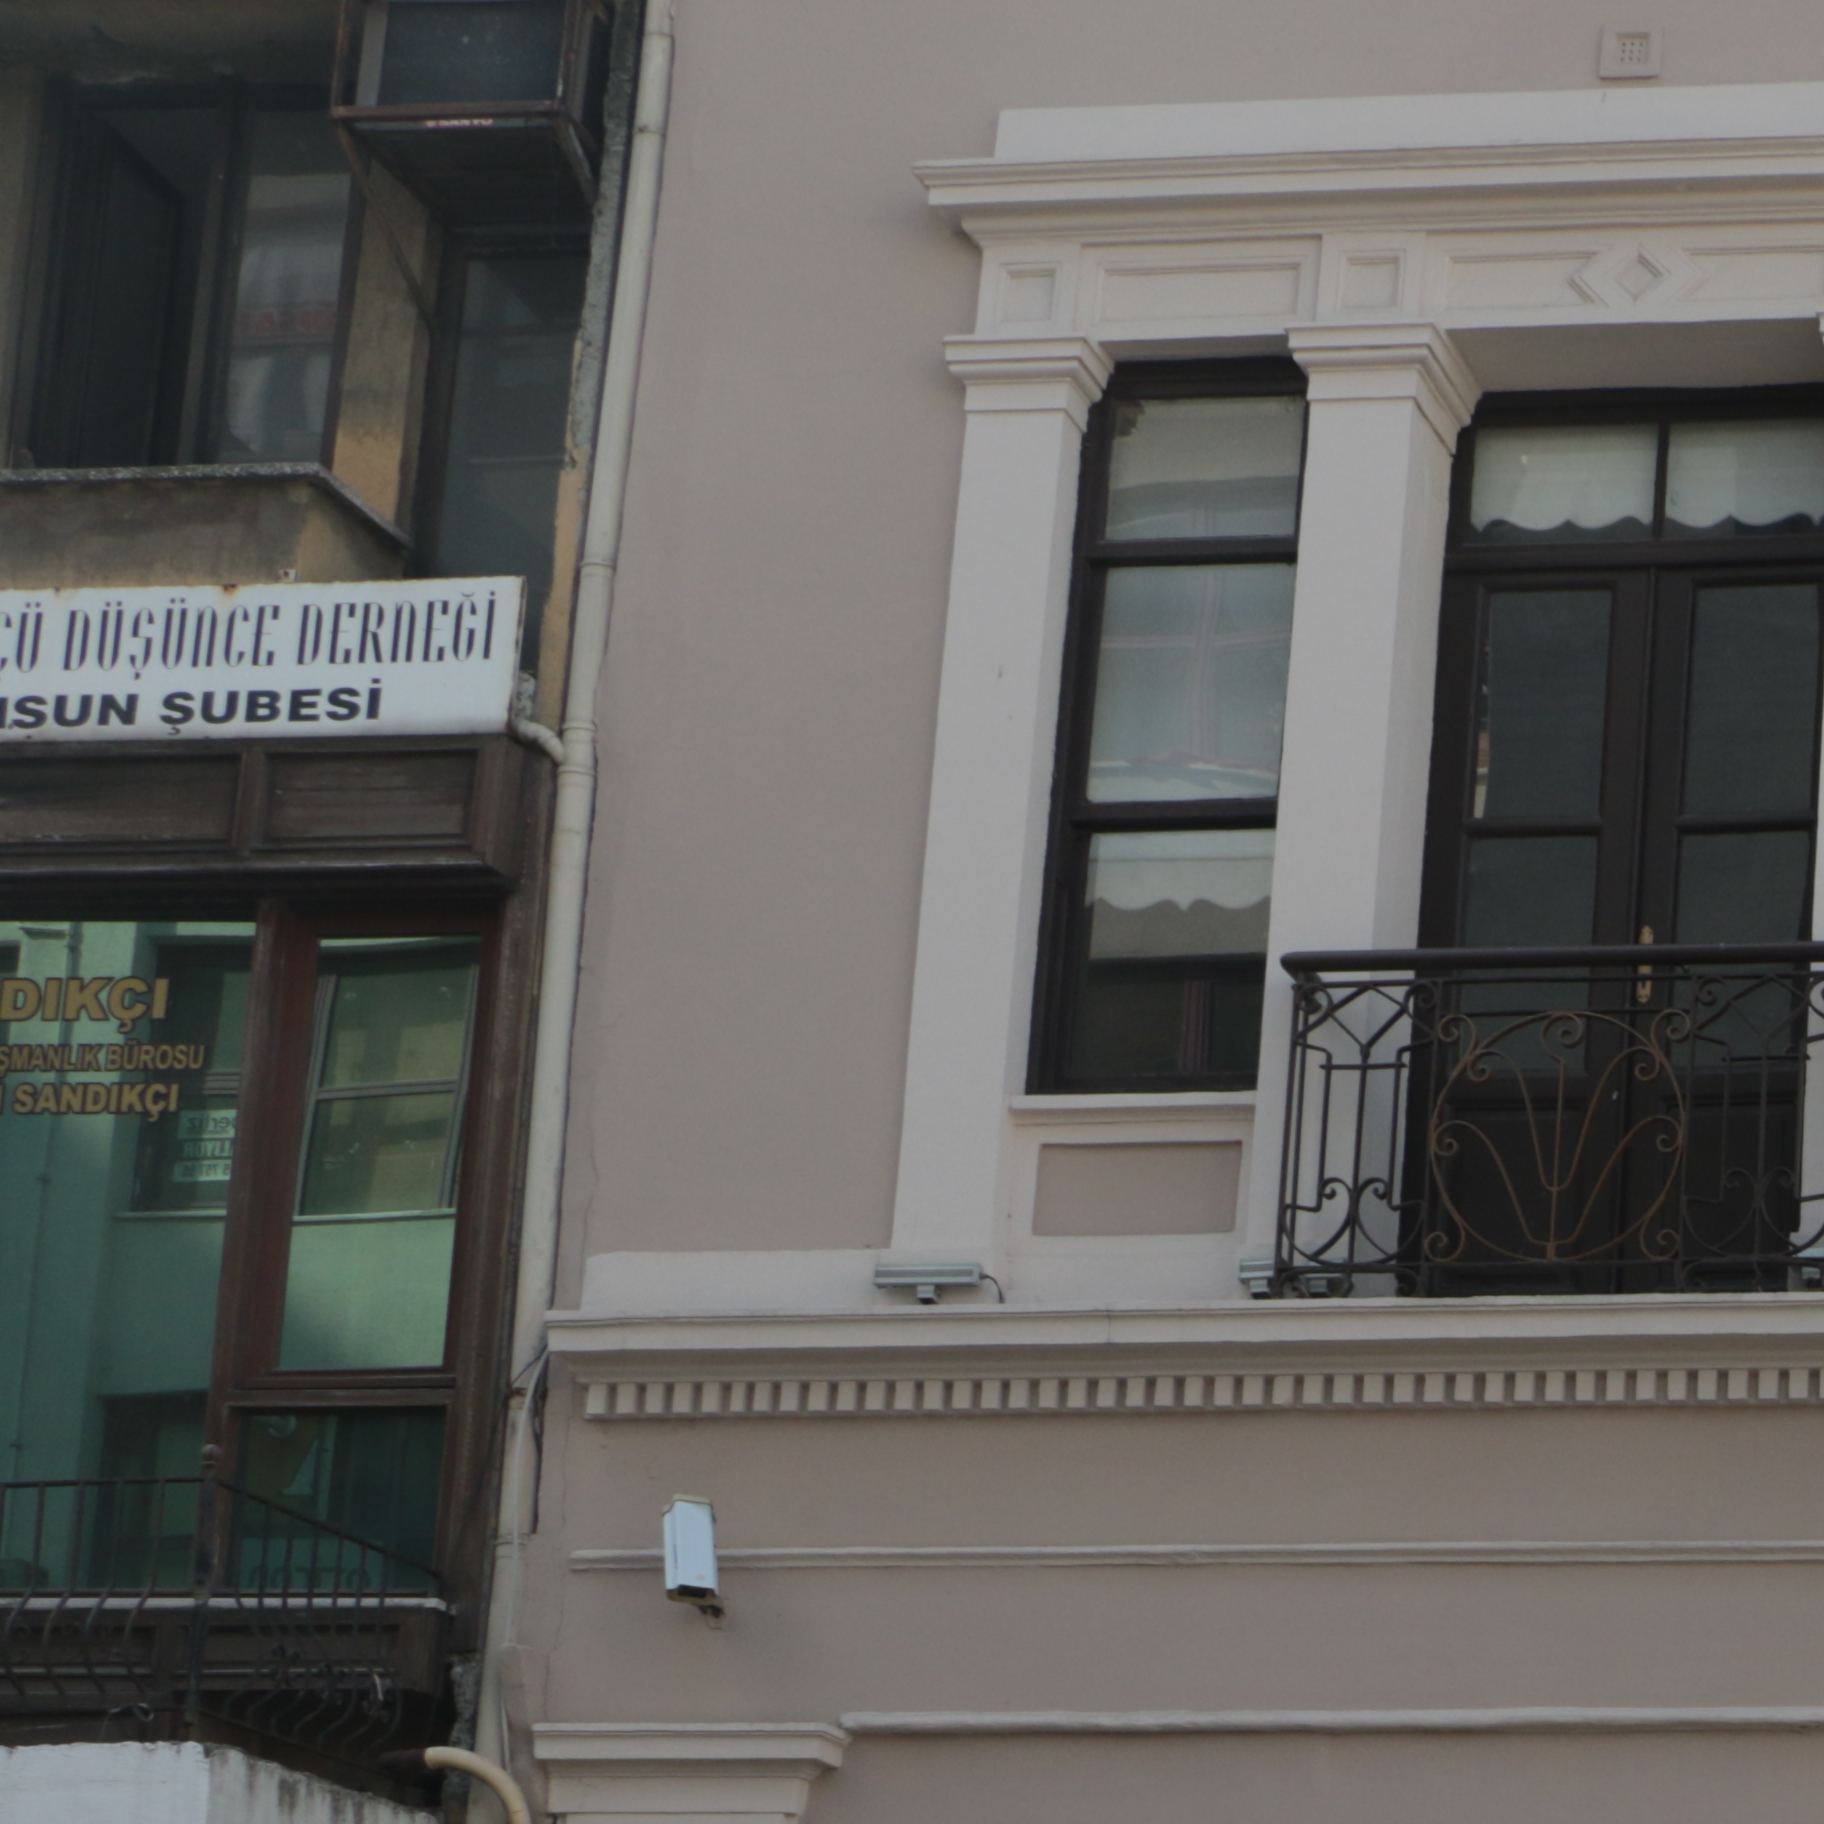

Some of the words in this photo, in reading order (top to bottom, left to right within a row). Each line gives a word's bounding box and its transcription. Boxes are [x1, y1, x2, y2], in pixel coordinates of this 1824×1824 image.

[63, 598, 281, 680] DÜŞÜNCE
[297, 590, 497, 666] DERNEĞİ
[0, 693, 139, 730] SUN
[160, 678, 384, 735] ŞUBESİ
[105, 1039, 206, 1071] BÜROSU
[12, 1083, 180, 1122] SANDIKÇI
